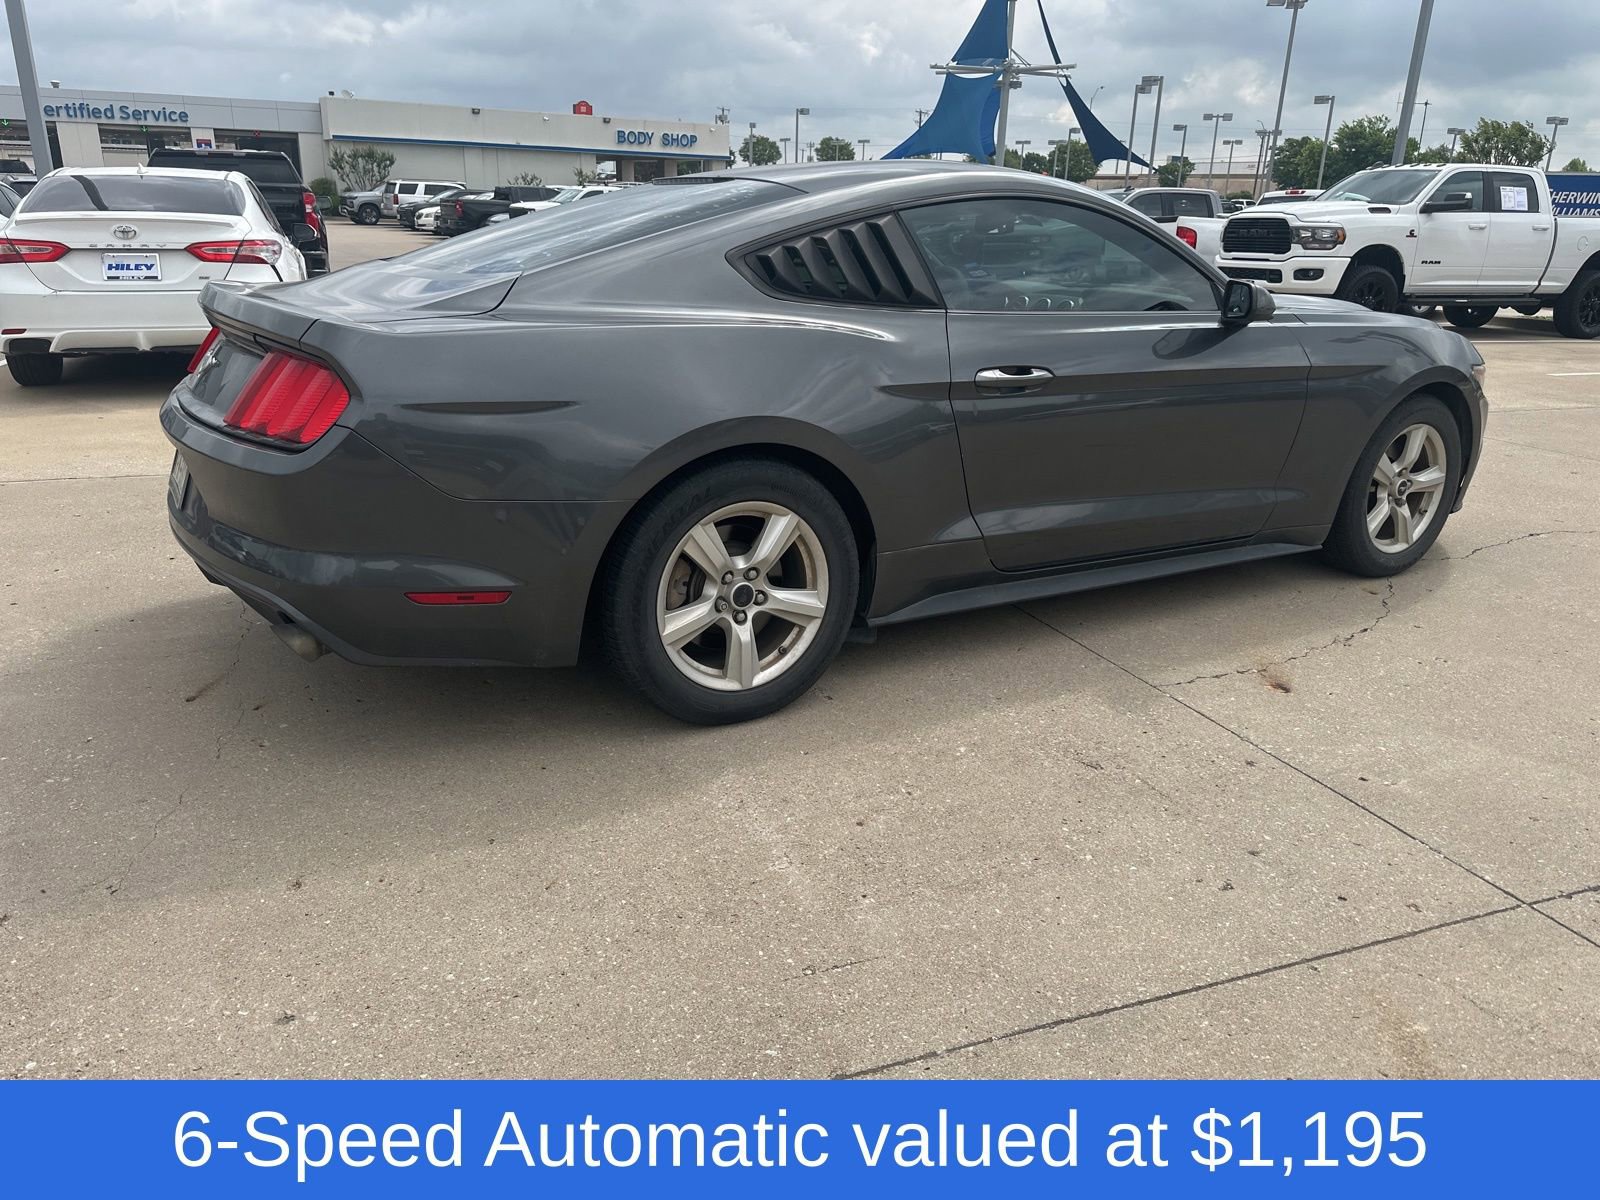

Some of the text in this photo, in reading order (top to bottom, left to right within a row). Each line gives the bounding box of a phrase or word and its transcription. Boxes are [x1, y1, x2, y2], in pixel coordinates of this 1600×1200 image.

[43, 102, 189, 123] ertified Service
[616, 130, 698, 148] BODY SHOP
[107, 263, 155, 271] HILEY
